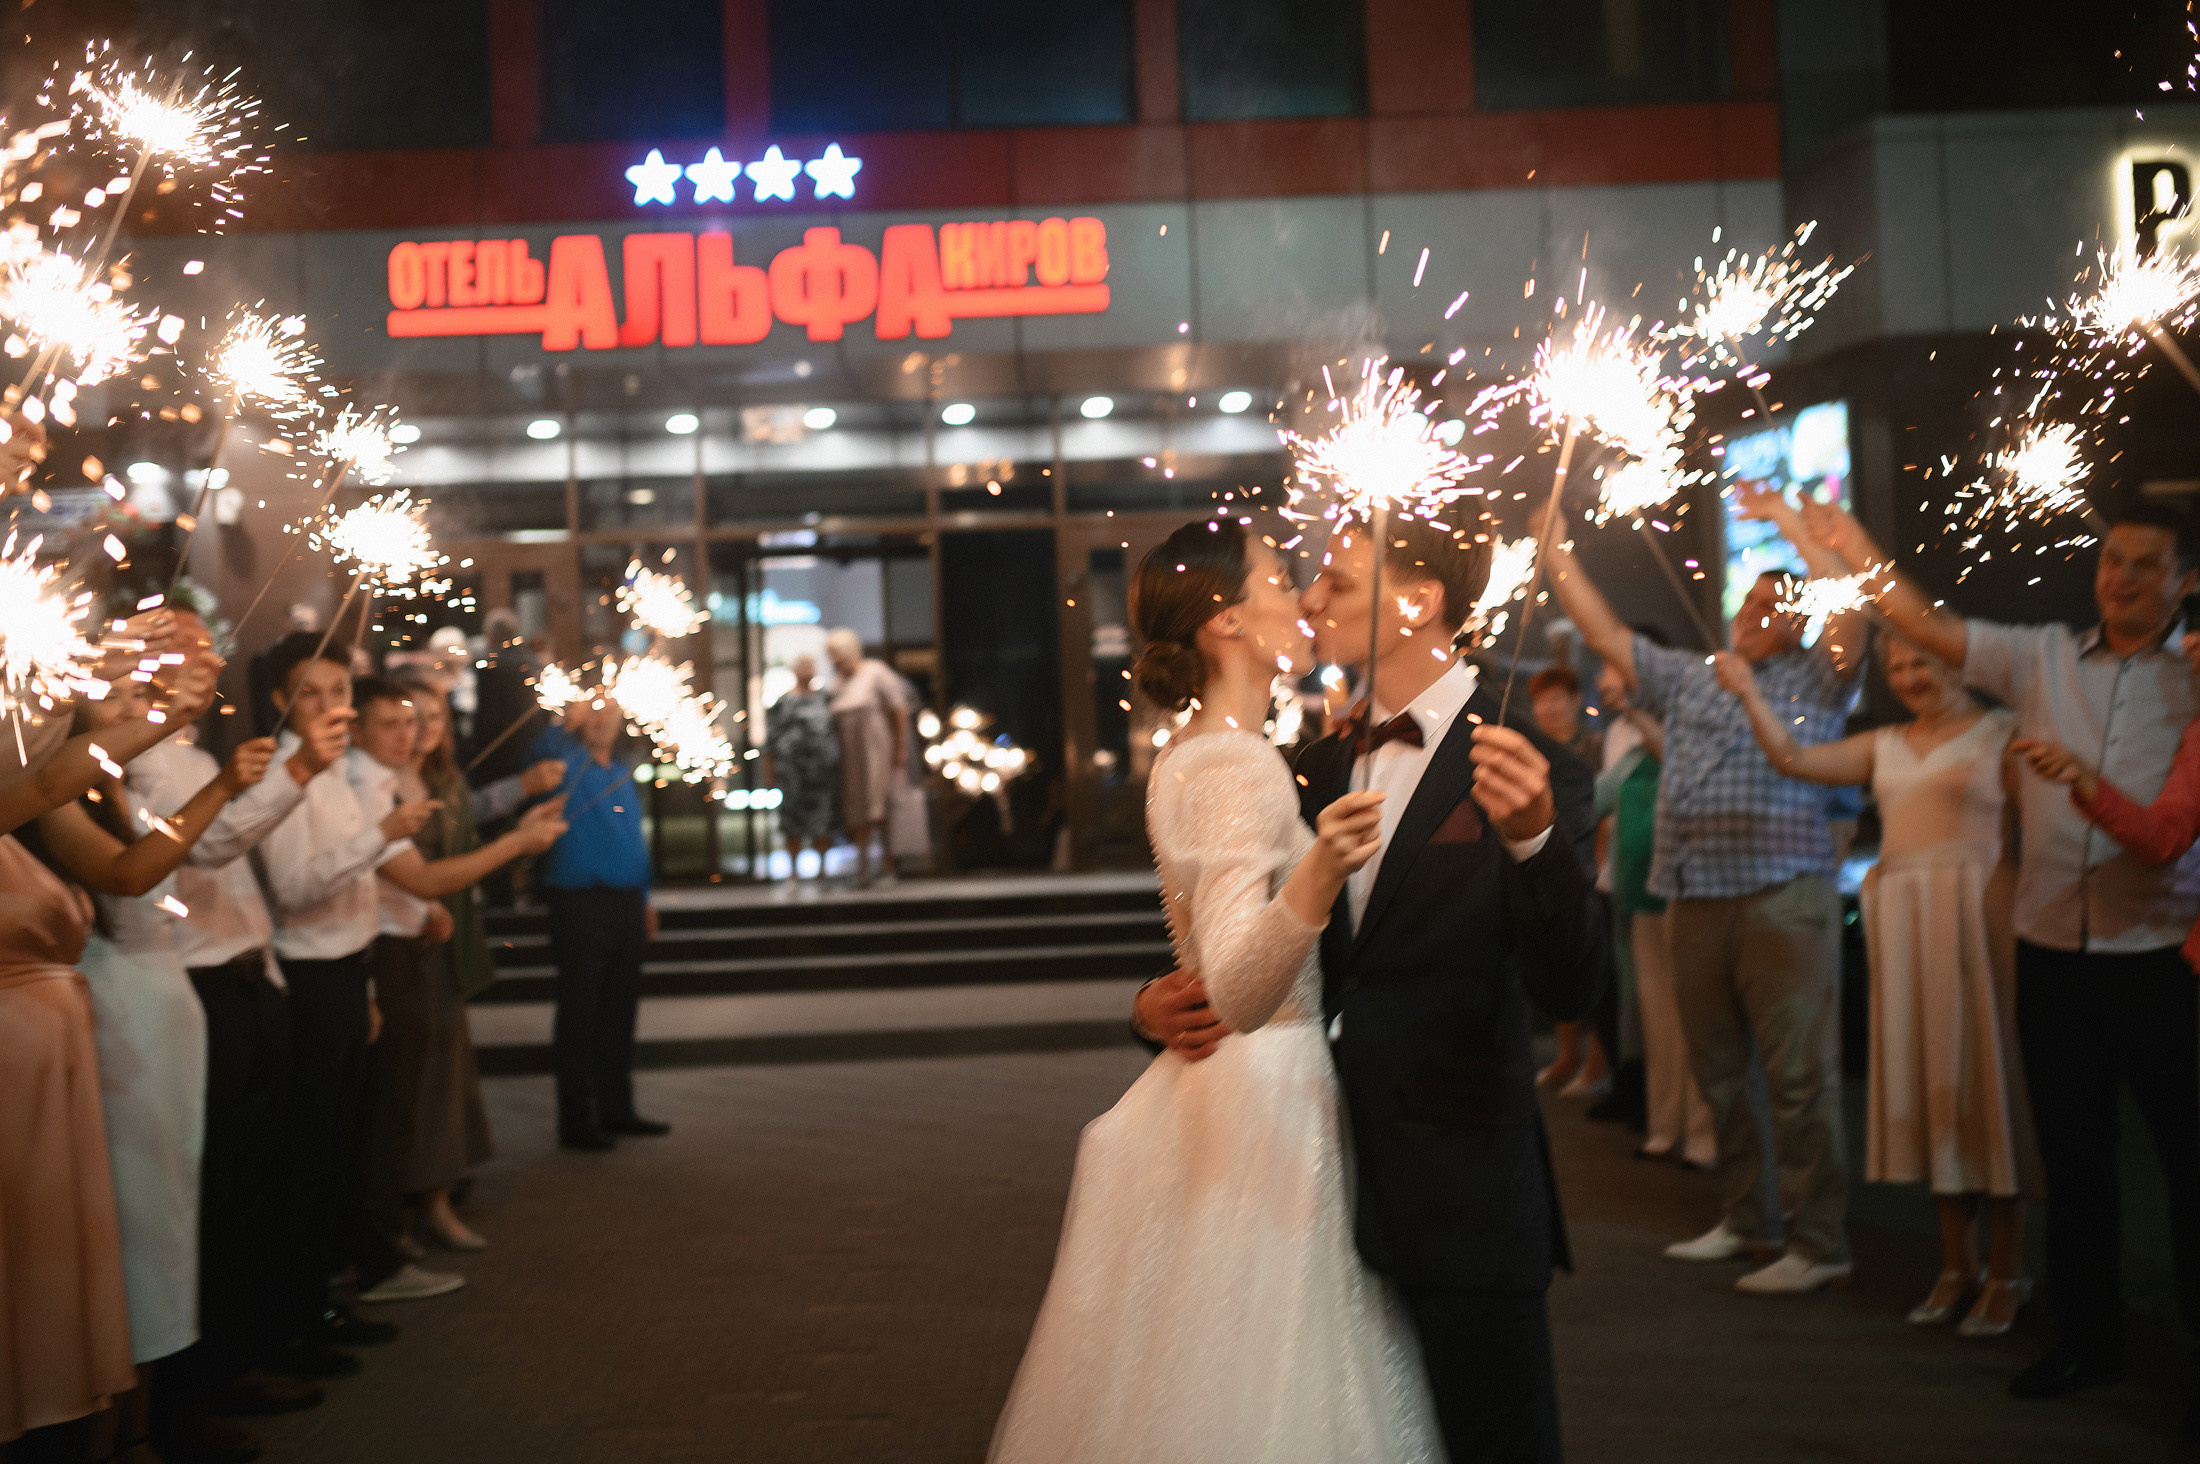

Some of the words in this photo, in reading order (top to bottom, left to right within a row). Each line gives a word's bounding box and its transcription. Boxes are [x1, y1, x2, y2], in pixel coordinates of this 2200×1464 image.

[388, 239, 545, 310] ОТЕЛЬ
[542, 222, 953, 351] АЛЬФА
[938, 216, 1109, 291] КИРОВ
